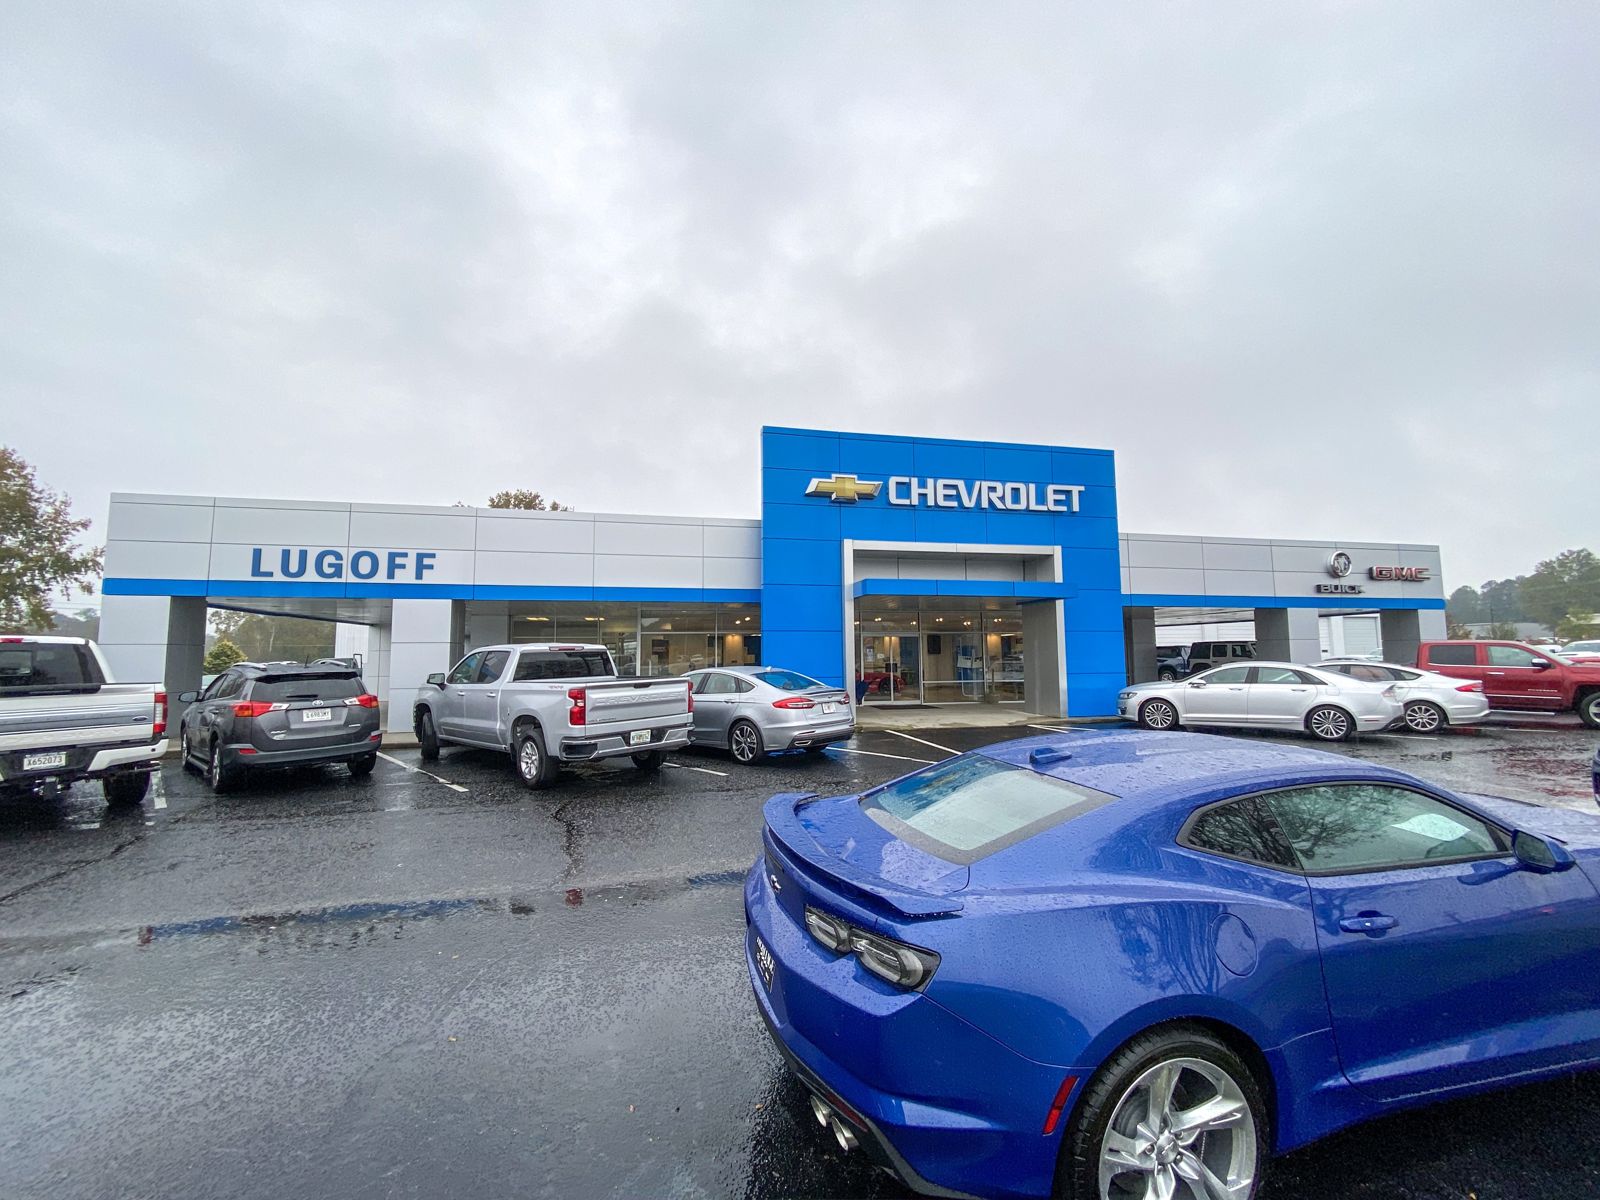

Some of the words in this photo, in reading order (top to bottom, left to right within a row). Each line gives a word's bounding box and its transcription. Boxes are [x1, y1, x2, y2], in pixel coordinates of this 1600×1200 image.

[887, 476, 1086, 513] CHEVROLET
[250, 547, 437, 580] LUGOFF
[1371, 566, 1430, 582] GMC
[1317, 583, 1364, 595] BUICK
